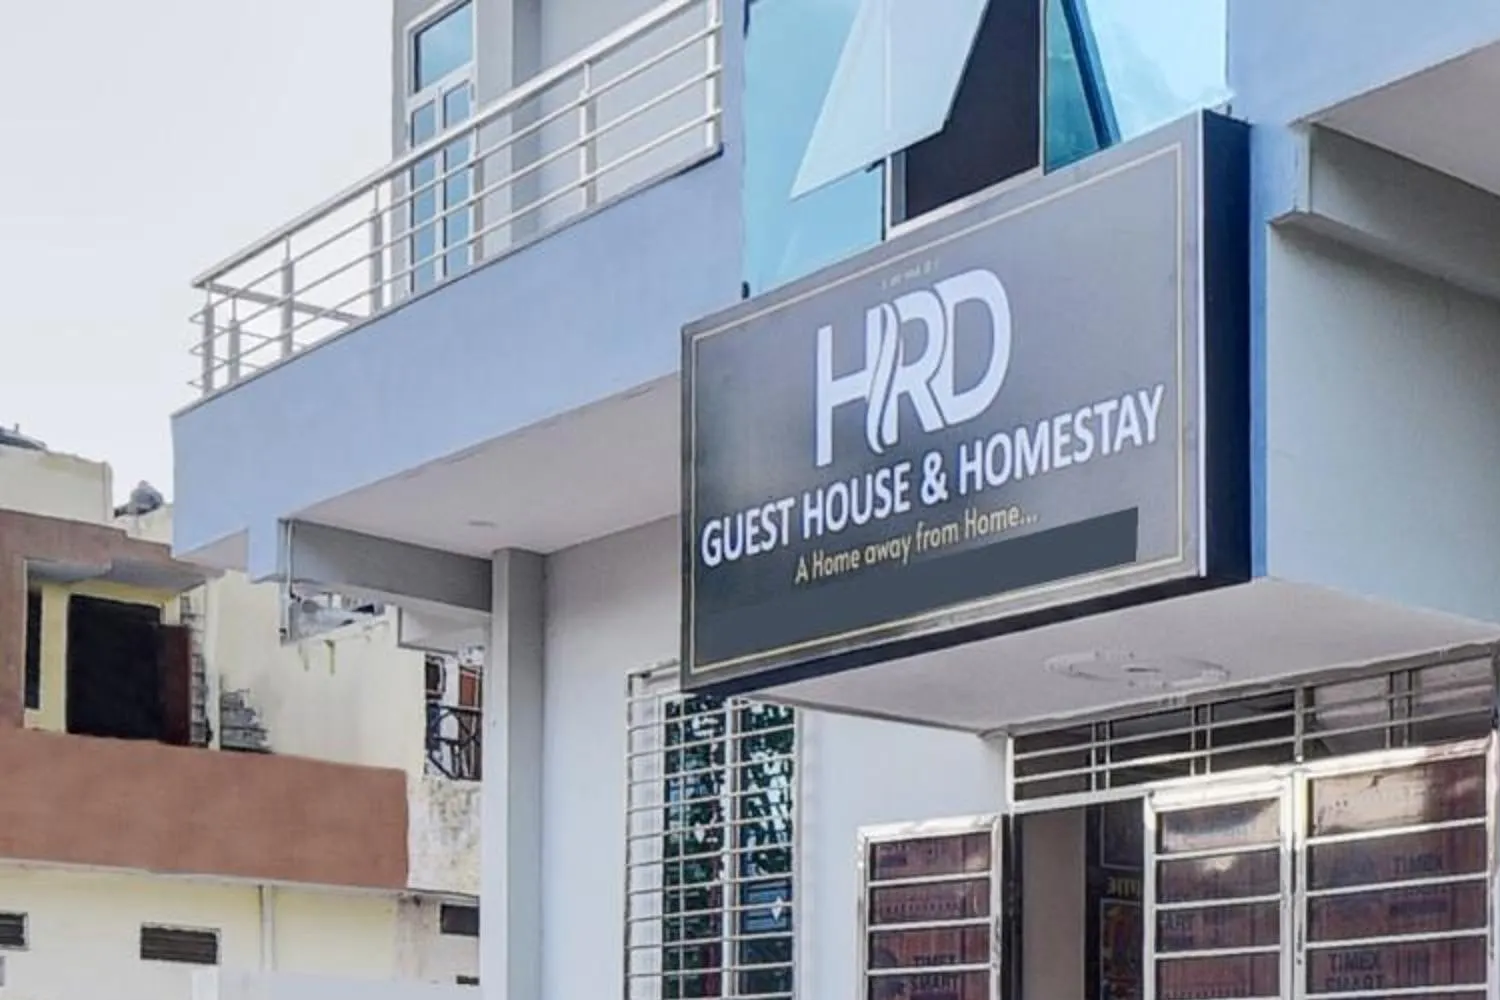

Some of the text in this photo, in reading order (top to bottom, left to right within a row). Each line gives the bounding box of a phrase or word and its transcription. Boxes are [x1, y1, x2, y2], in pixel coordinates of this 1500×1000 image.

[817, 269, 1012, 467] HRD
[701, 385, 1166, 567] GUEST HOUSE & HOMESTAY
[795, 558, 809, 584] A
[813, 552, 860, 579] Home
[864, 536, 912, 565] away
[916, 519, 960, 553] from
[1327, 951, 1381, 973] TIMEX
